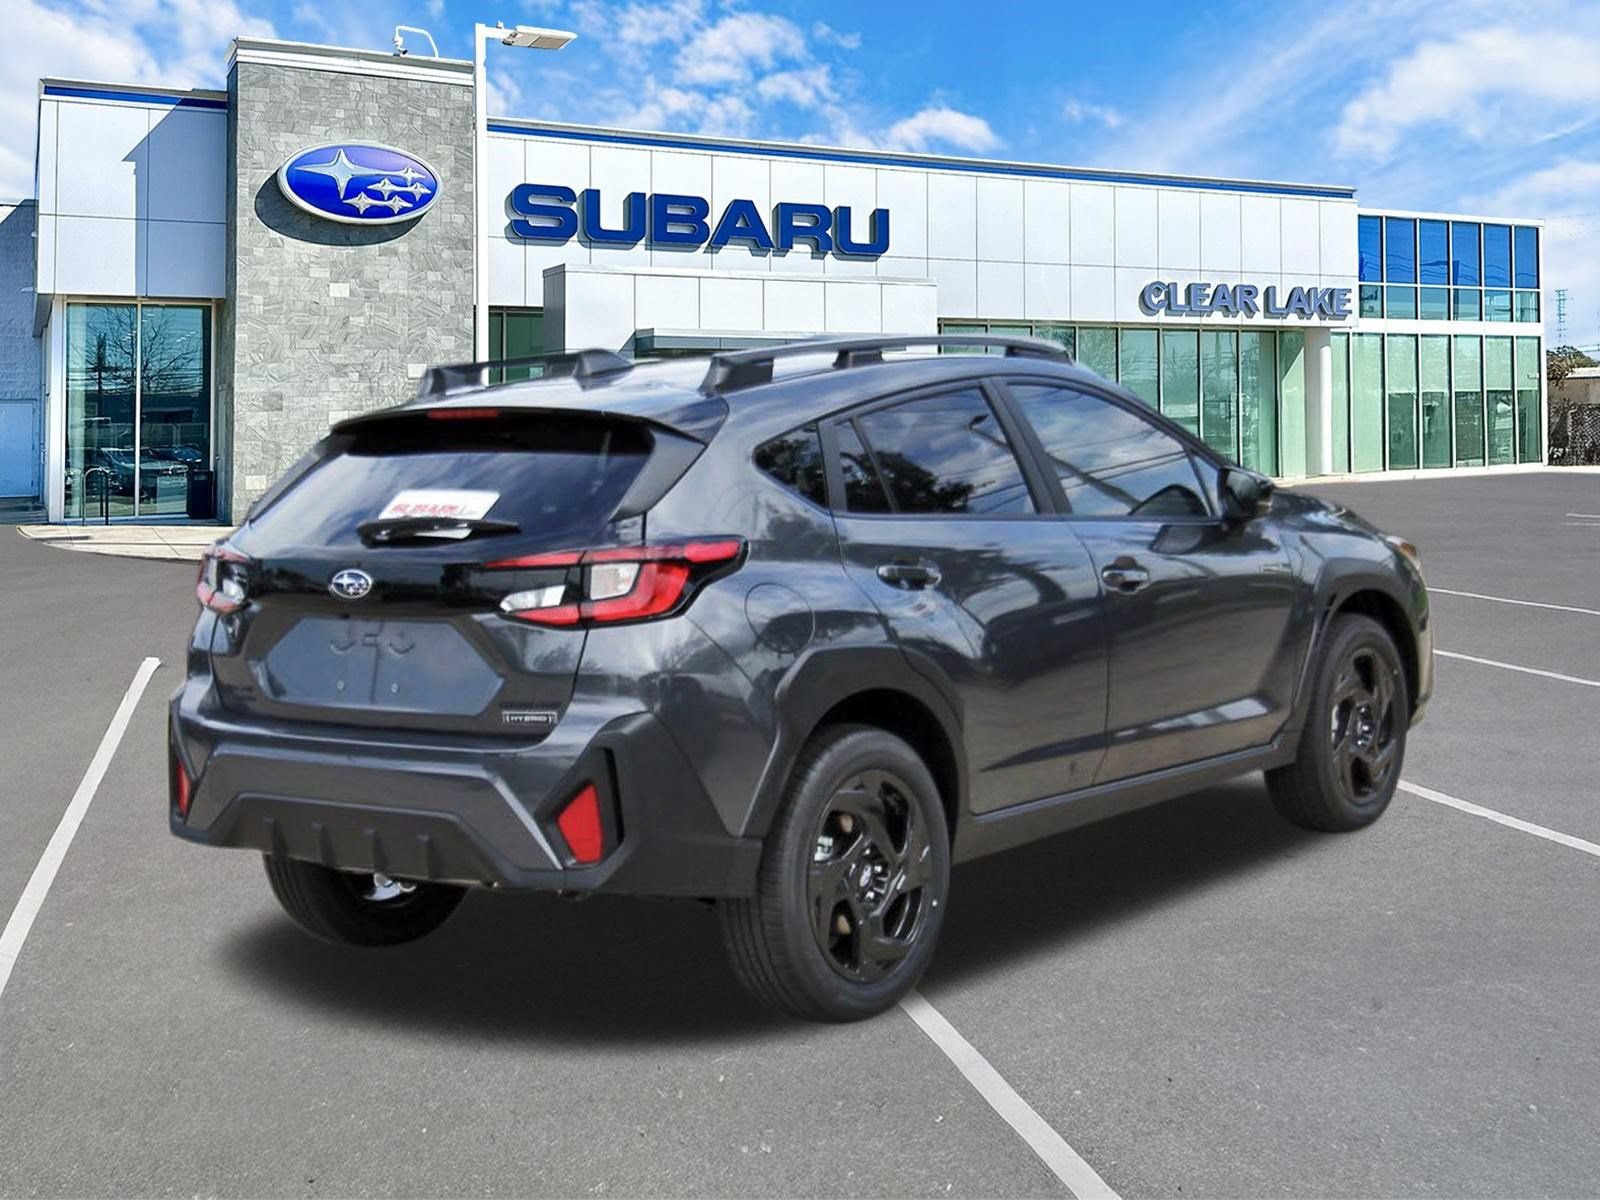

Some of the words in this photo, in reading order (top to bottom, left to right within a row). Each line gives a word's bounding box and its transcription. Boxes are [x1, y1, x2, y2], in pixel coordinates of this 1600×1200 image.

[505, 183, 890, 260] SUBARU
[1140, 281, 1260, 316] CLEAR
[1264, 285, 1352, 319] LAKE
